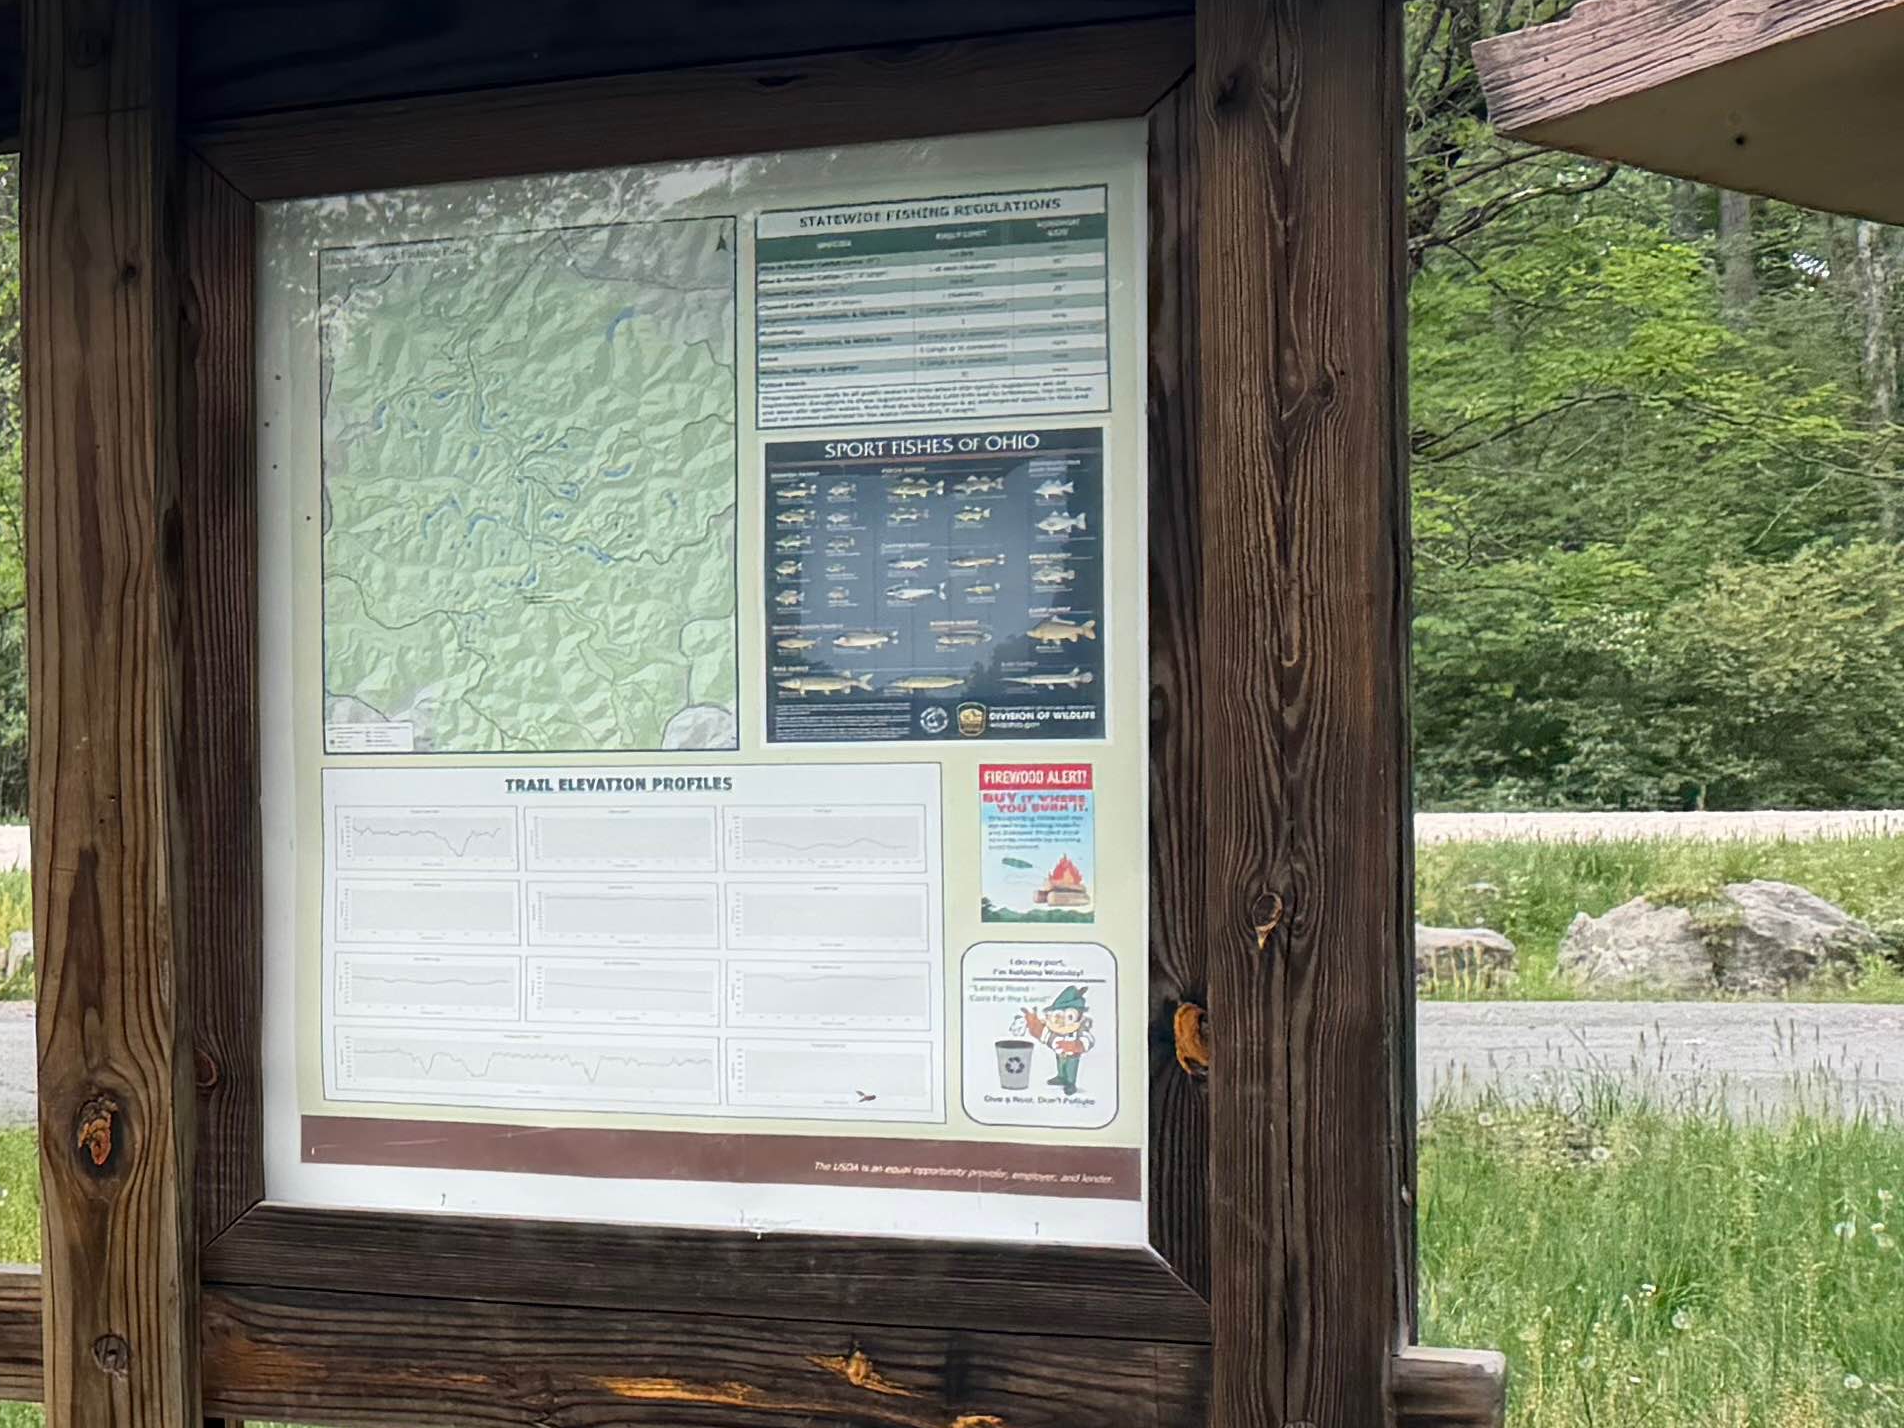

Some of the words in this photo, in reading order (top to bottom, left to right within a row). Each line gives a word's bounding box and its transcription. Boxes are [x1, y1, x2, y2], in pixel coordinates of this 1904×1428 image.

[799, 212, 882, 228] STATEWIDE
[886, 206, 950, 222] FISHING
[954, 198, 1062, 216] REGULATIONS
[824, 441, 886, 459] SPORT
[892, 438, 954, 456] FISHES
[984, 433, 1040, 451] OHIO
[989, 712, 1034, 721] DIVISION
[1038, 712, 1050, 720] OF
[505, 778, 554, 792] TRAIL
[558, 777, 647, 792] ELEVATION
[652, 776, 732, 792] PROFILES
[984, 770, 1044, 784] FIREWOOD
[1047, 770, 1088, 784] ALERT!
[983, 792, 1018, 803] BUY
[997, 804, 1027, 812] YOU
[815, 1161, 832, 1172] The
[833, 1162, 859, 1172] USDA
[914, 1167, 964, 1178] opportunity
[1060, 1173, 1080, 1182] and
